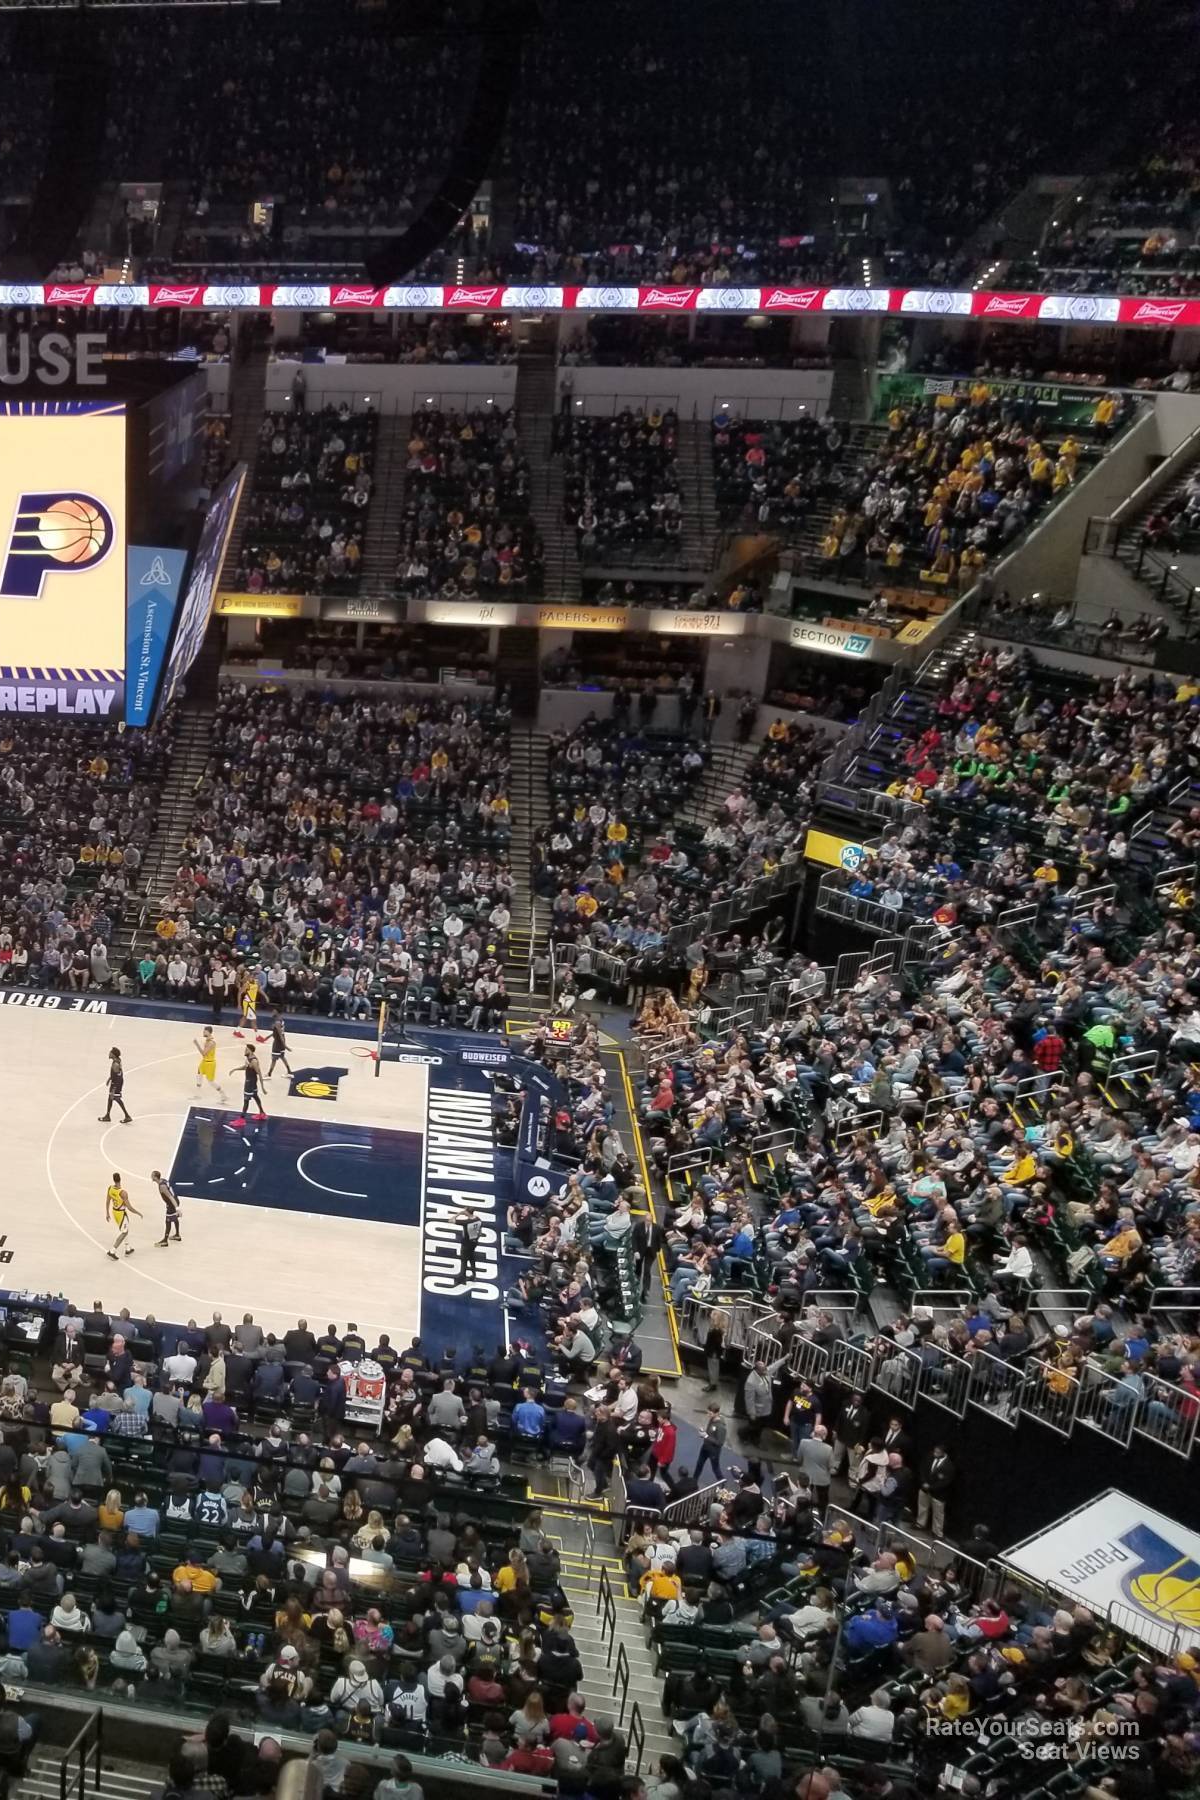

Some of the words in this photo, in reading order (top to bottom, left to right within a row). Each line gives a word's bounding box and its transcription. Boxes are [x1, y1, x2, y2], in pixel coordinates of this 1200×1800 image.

[141, 599, 158, 655] Ascension
[791, 627, 846, 647] SECTION
[846, 638, 866, 653] 127
[139, 654, 152, 671] St.
[134, 670, 150, 712] Vincent
[70, 998, 109, 1015] WE
[552, 1028, 566, 1038] 22
[398, 1053, 443, 1066] GEICO
[462, 1051, 507, 1063] BUDWEISER
[426, 1087, 495, 1183] INDIANA
[422, 1186, 500, 1301] PACERS
[201, 1508, 220, 1524] 22
[1059, 1541, 1129, 1585] Pacers
